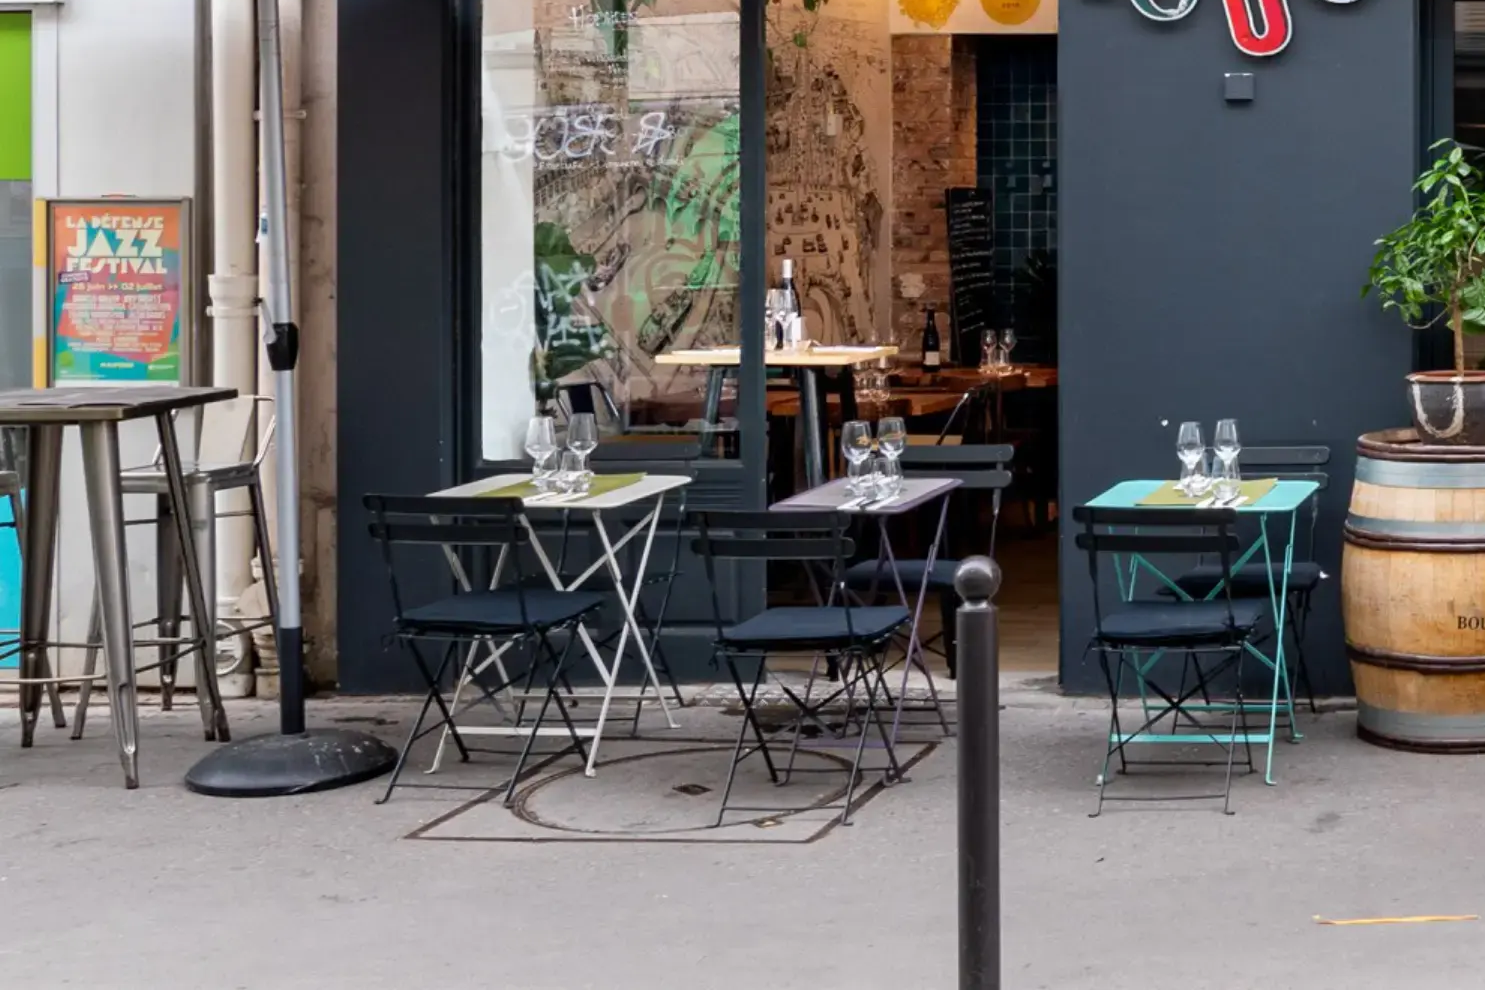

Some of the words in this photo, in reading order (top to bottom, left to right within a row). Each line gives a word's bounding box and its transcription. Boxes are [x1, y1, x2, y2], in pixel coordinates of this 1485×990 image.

[66, 215, 87, 229] LA
[91, 212, 165, 229] DÉFENSE
[66, 229, 164, 257] JAZZ
[66, 257, 168, 274] FESTIVAL
